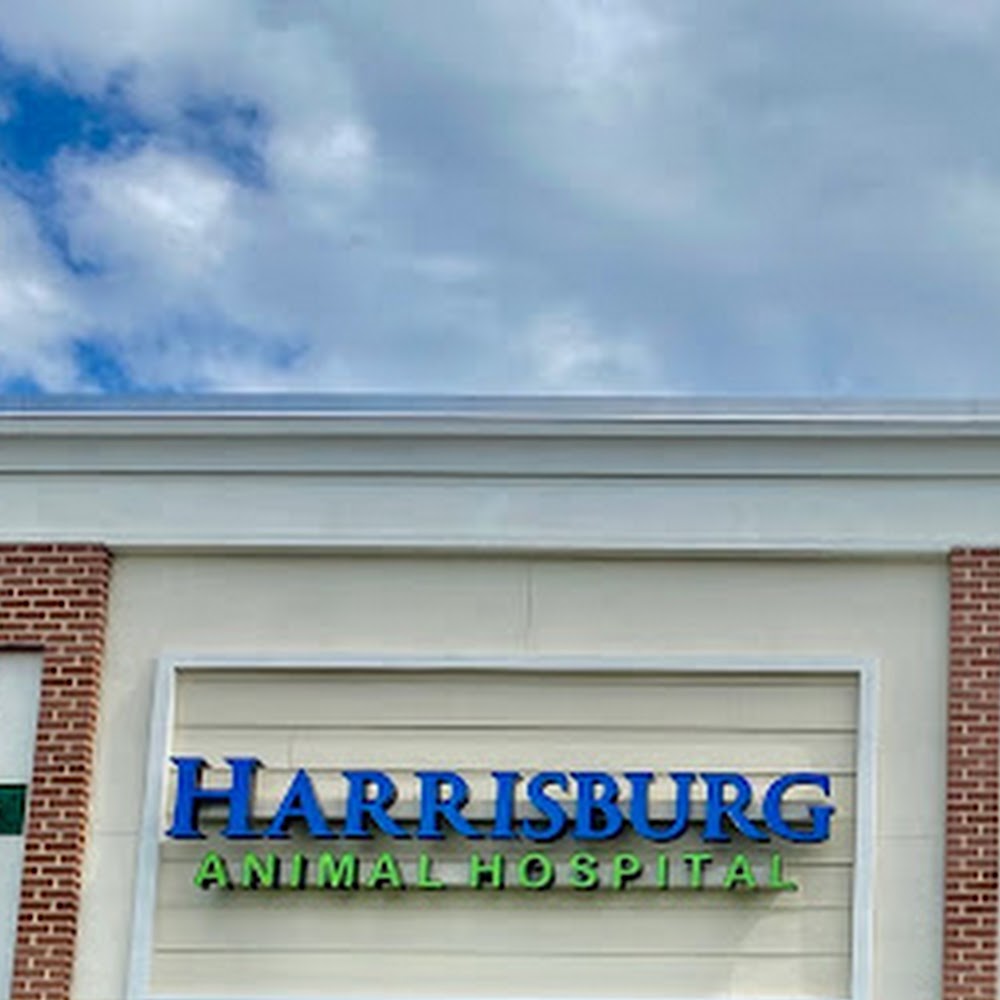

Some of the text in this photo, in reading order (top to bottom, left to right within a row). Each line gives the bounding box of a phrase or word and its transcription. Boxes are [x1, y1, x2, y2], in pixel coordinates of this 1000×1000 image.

[165, 756, 835, 842] HARRISBURG
[194, 851, 798, 890] ANIMAL HOSPITAL
